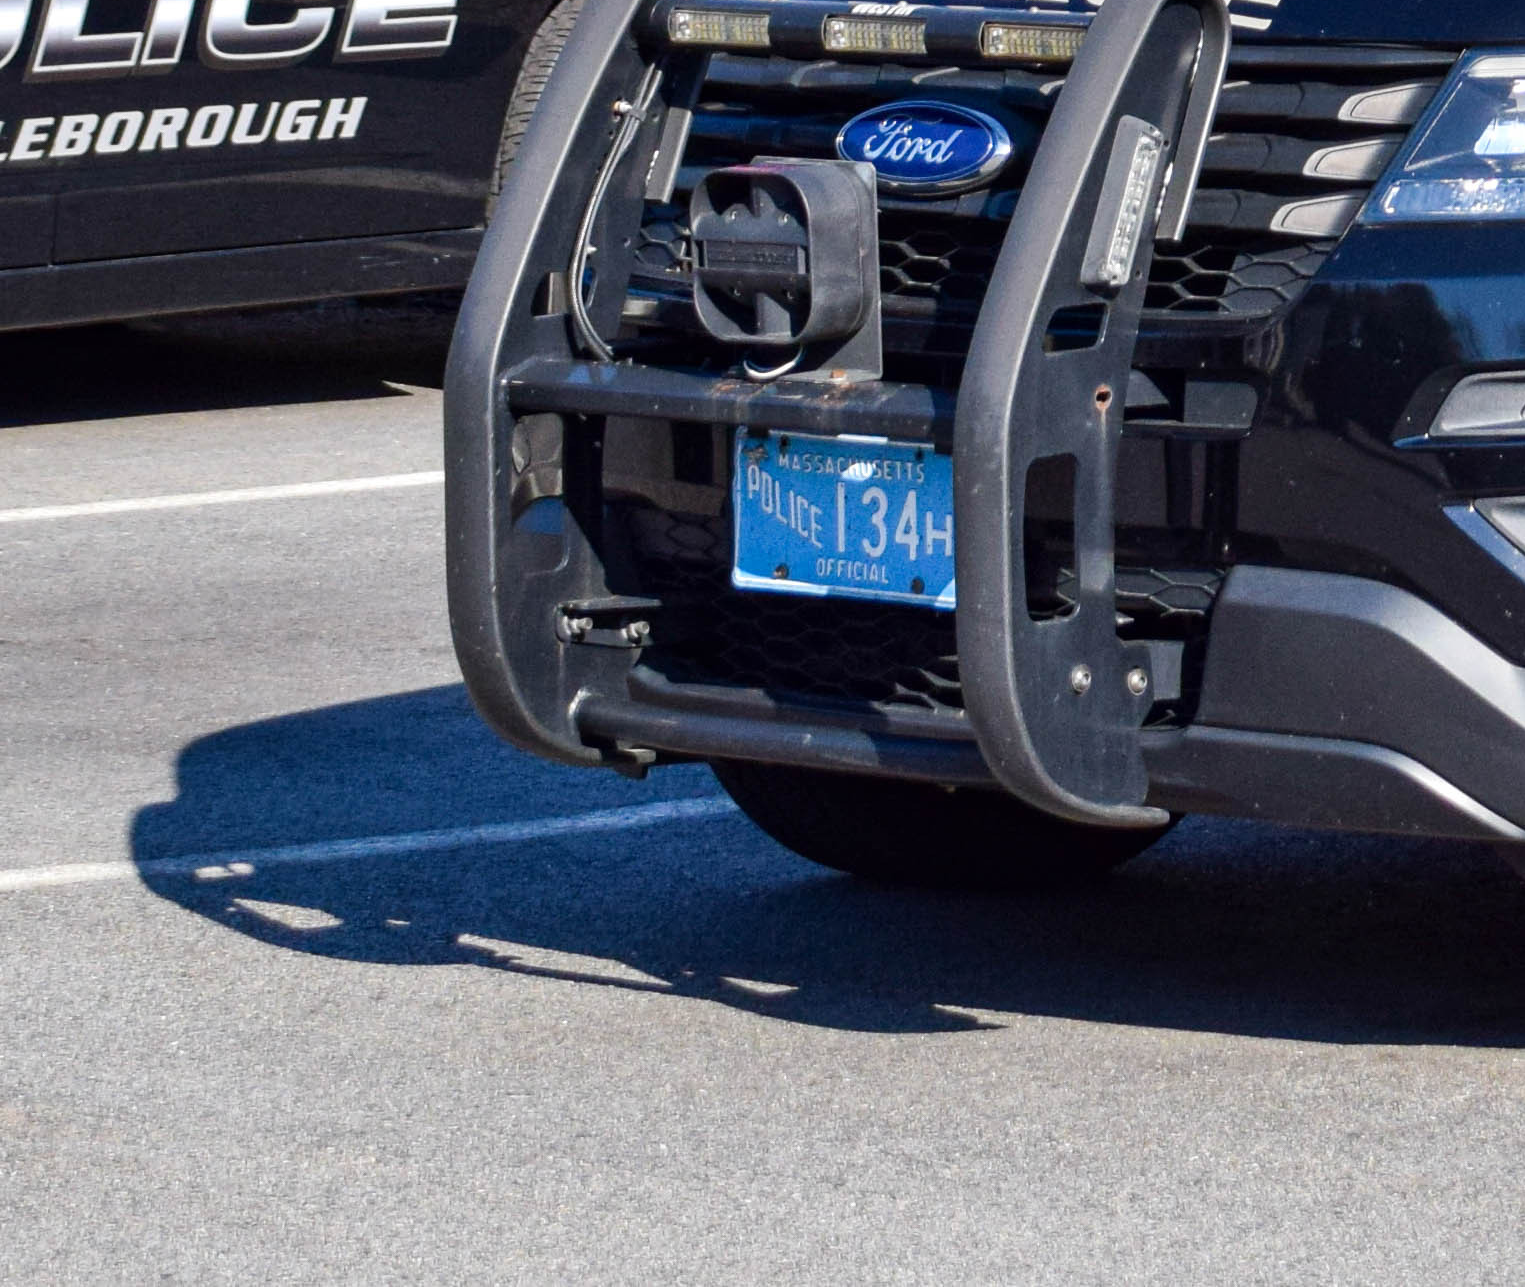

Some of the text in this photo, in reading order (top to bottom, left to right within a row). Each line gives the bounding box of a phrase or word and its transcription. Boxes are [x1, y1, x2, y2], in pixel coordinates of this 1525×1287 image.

[0, 97, 368, 162] EBOROUGH
[863, 114, 963, 164] Ford
[779, 453, 925, 483] MASSACHUSETTS
[747, 464, 823, 549] POLICE
[816, 558, 889, 584] OFFICIAL
